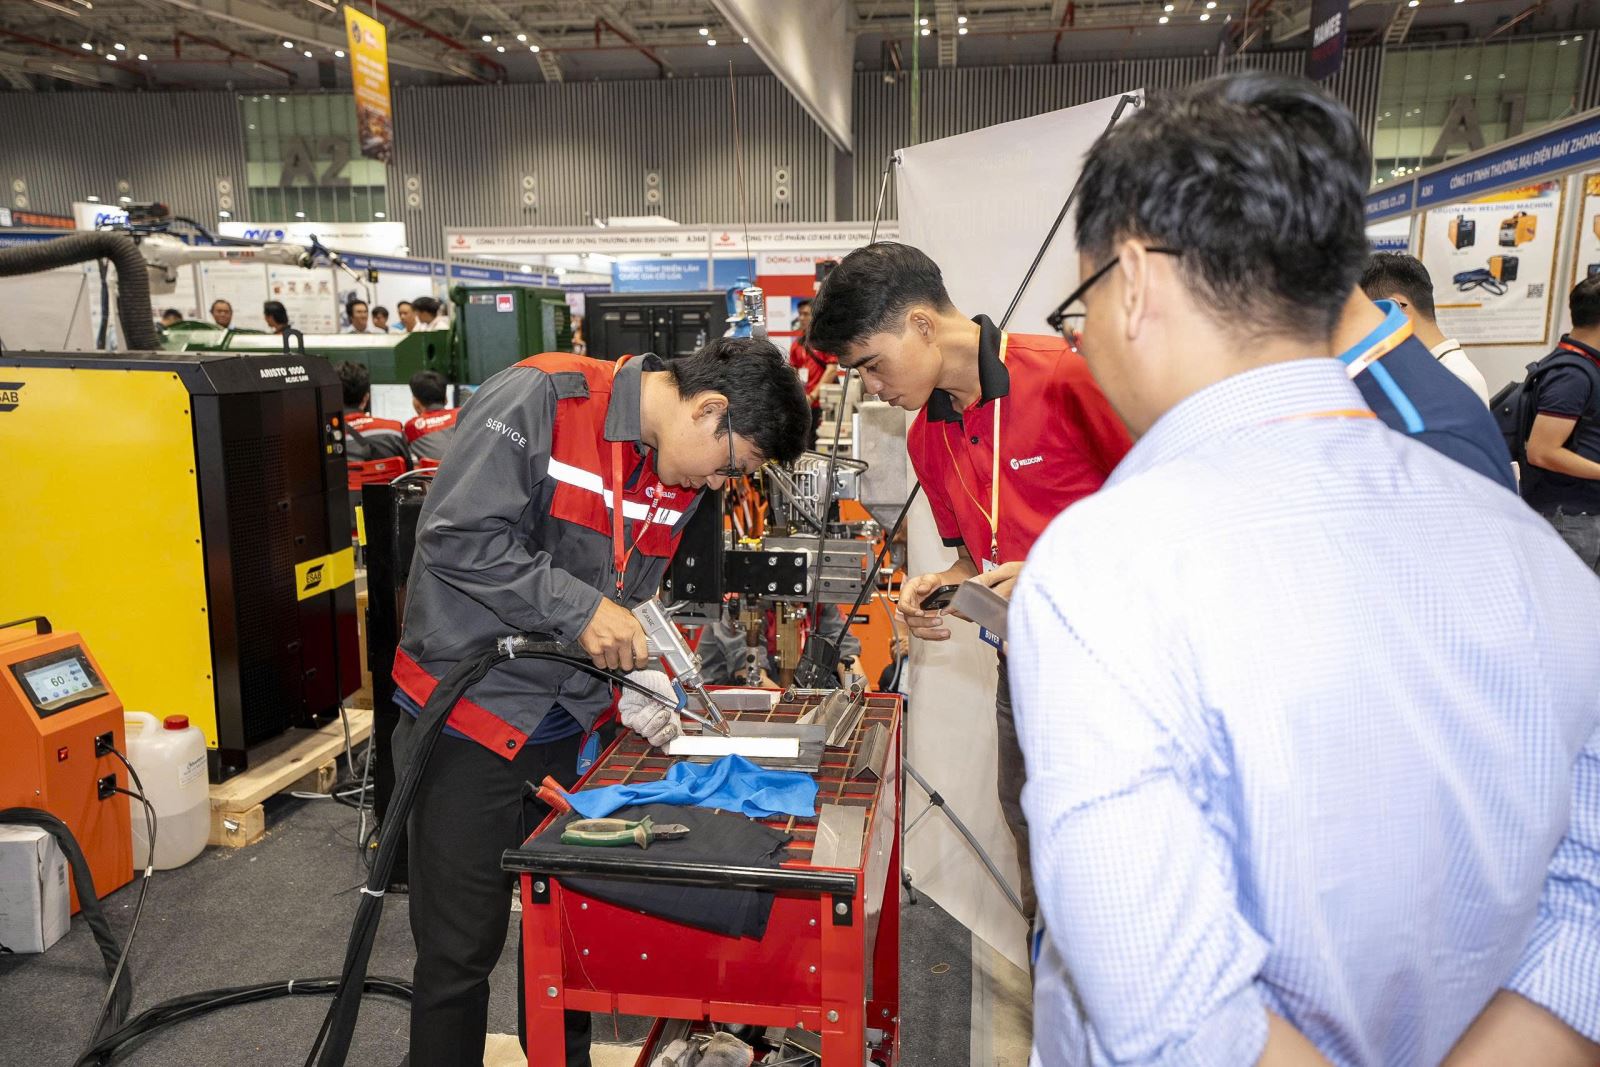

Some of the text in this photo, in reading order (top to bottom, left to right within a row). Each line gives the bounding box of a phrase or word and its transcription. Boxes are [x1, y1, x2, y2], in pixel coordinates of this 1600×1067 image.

[1519, 152, 1533, 171] MẠI
[1533, 145, 1552, 167] ĐIỆN
[1552, 138, 1571, 160] MÁY
[279, 137, 351, 187] A2
[260, 365, 306, 378] ARISTO 1000
[0, 391, 19, 403] AB
[486, 417, 528, 449] SERVICE
[1018, 455, 1044, 467] WELDCOM
[305, 570, 322, 585] ESAB
[50, 675, 66, 687] 60
